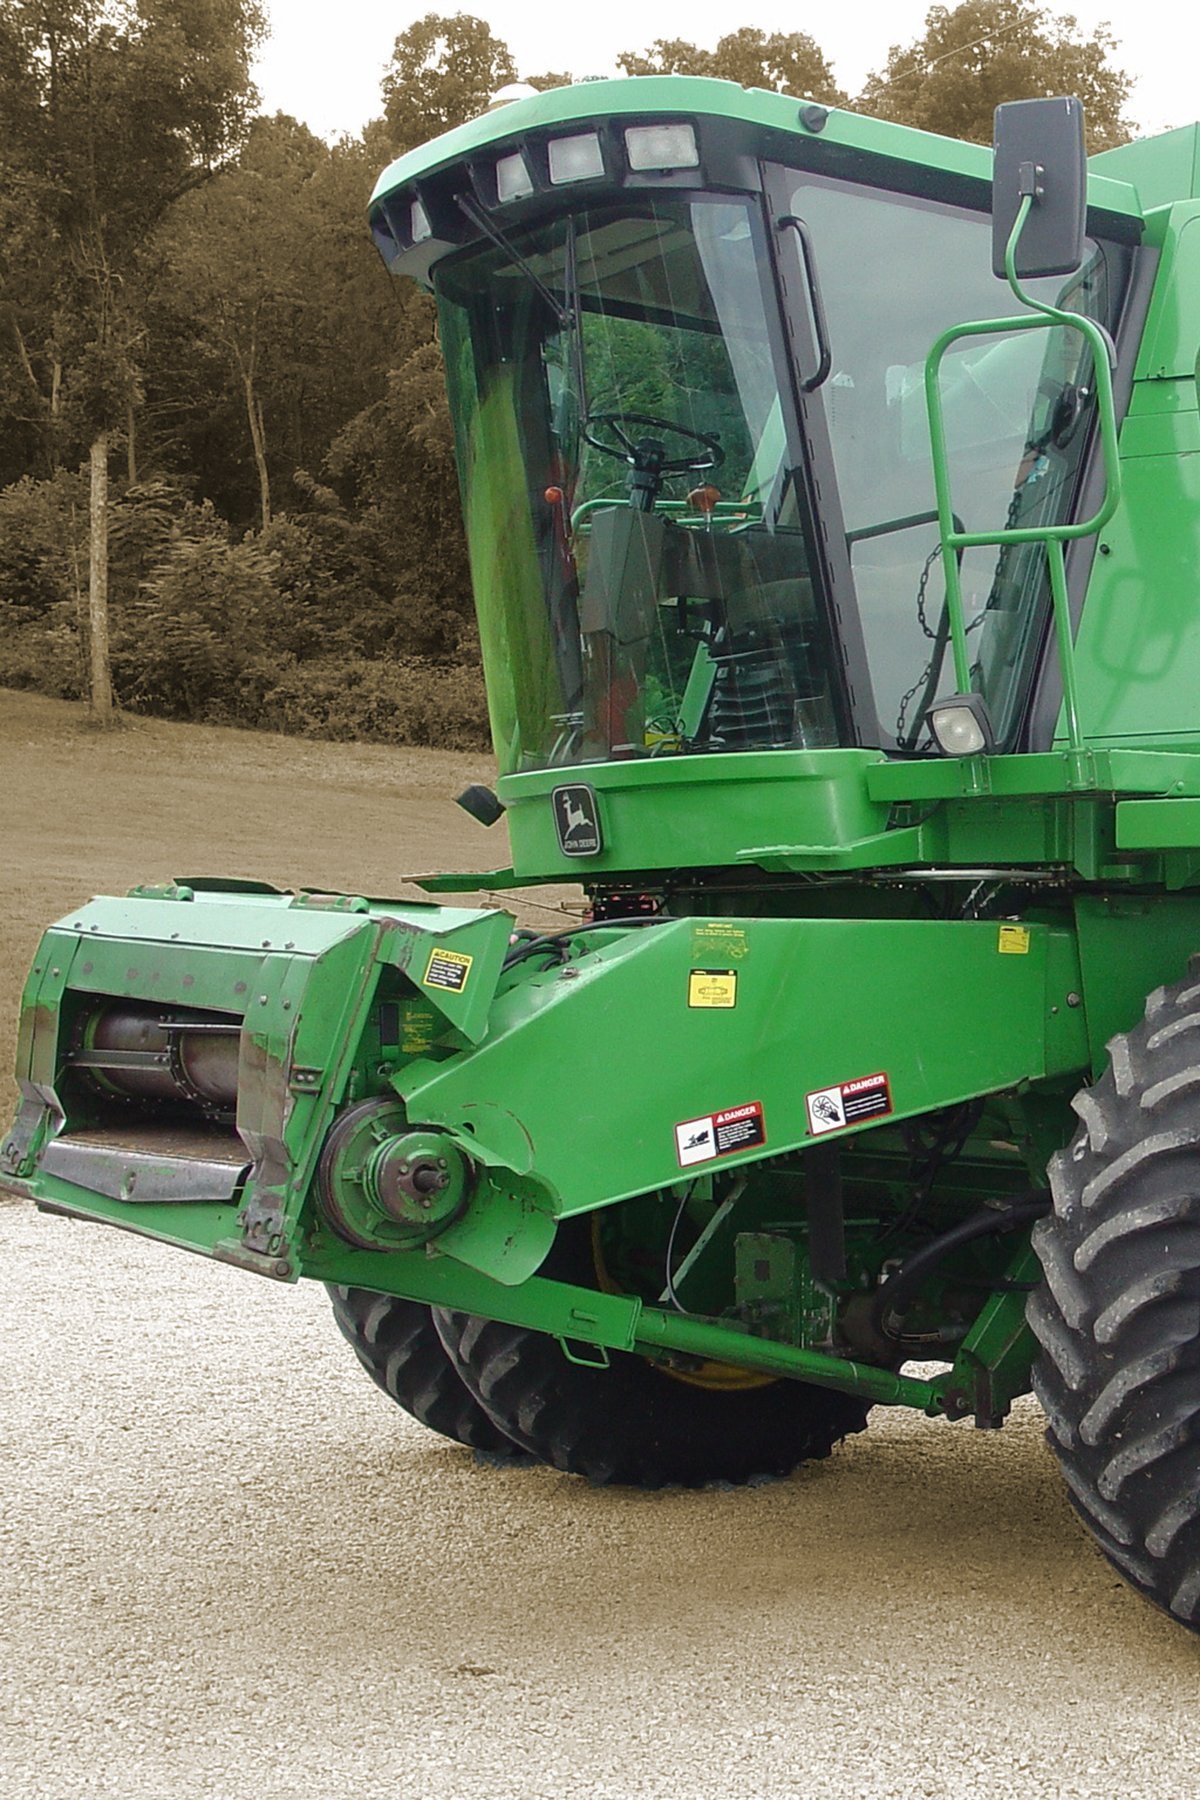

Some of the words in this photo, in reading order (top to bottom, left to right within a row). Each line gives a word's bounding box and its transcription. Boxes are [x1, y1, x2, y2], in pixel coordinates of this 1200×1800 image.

[564, 840, 578, 849] JOHN
[579, 839, 597, 848] DEERE
[440, 951, 471, 964] CAUTION
[849, 1075, 885, 1092] DANGER
[724, 1105, 756, 1121] DANGER
